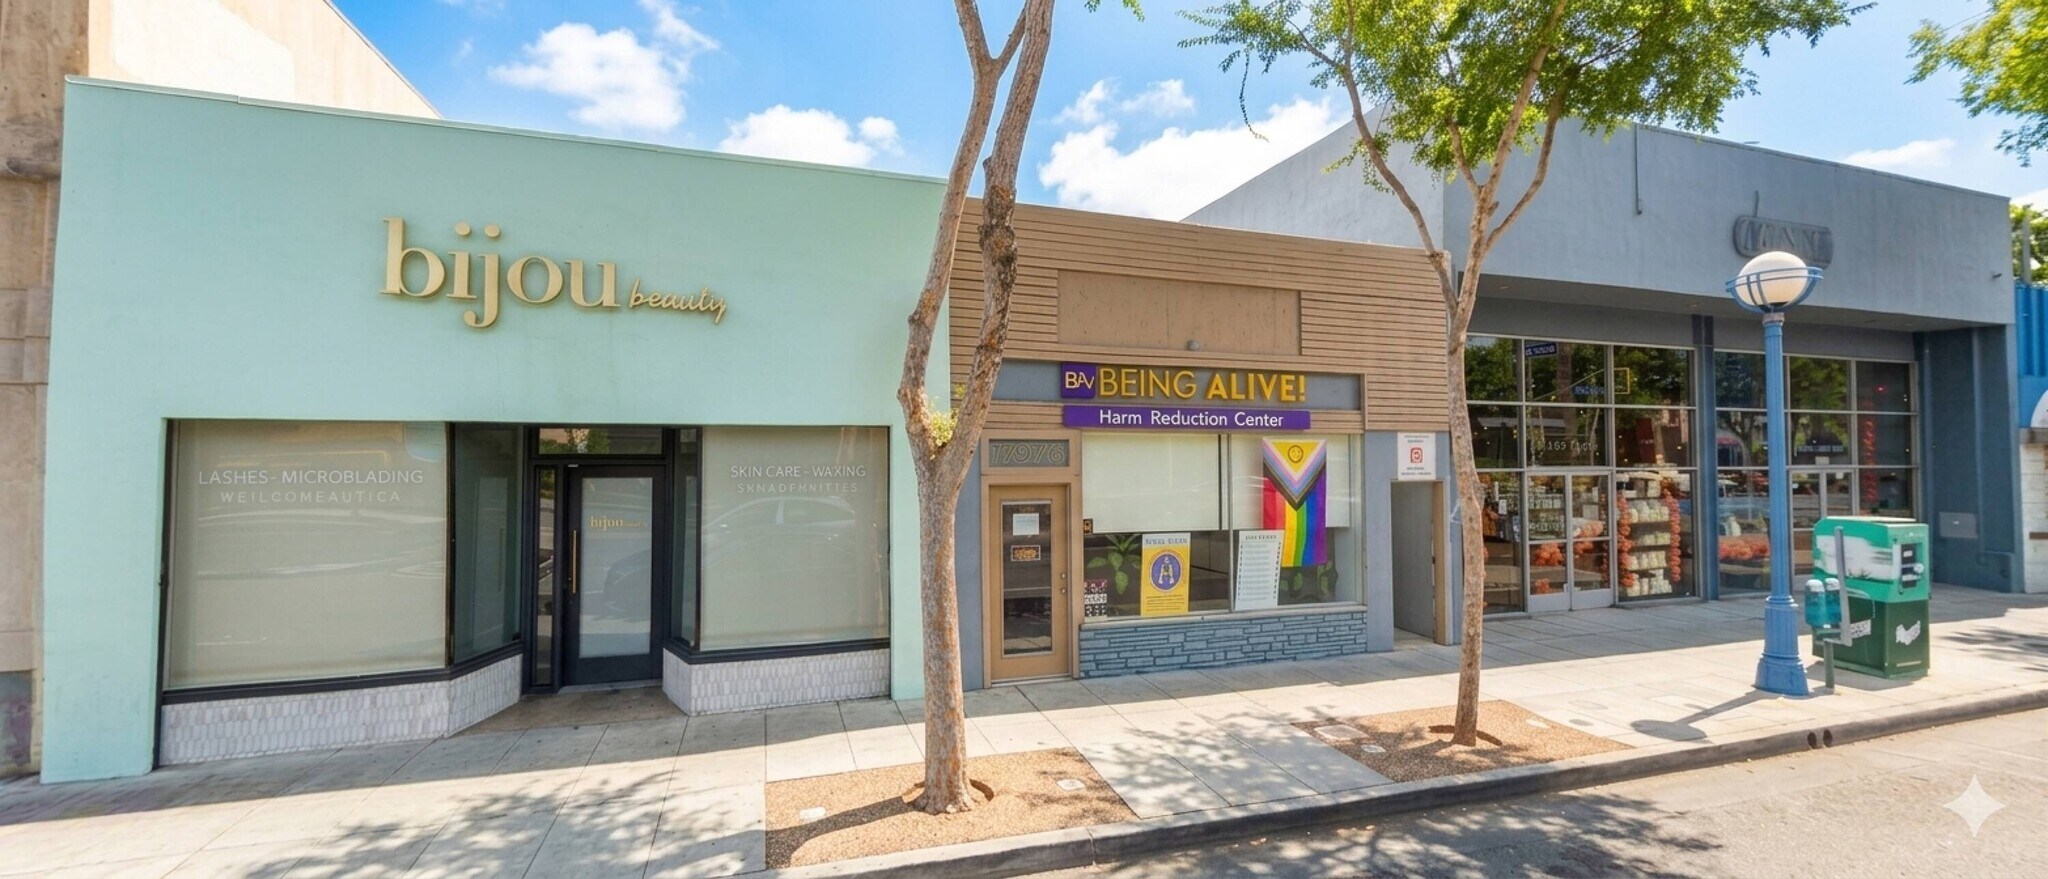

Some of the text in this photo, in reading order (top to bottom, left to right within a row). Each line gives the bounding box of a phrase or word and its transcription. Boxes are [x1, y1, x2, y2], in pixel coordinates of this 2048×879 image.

[380, 217, 621, 328] bijou
[1100, 368, 1306, 401] BEING ALIVE!
[1100, 410, 1283, 426] Harm Reduction Center
[281, 470, 423, 485] MICROBLADING
[730, 464, 762, 478] SKIN
[765, 465, 801, 478] CARE
[812, 464, 866, 478] WAXING
